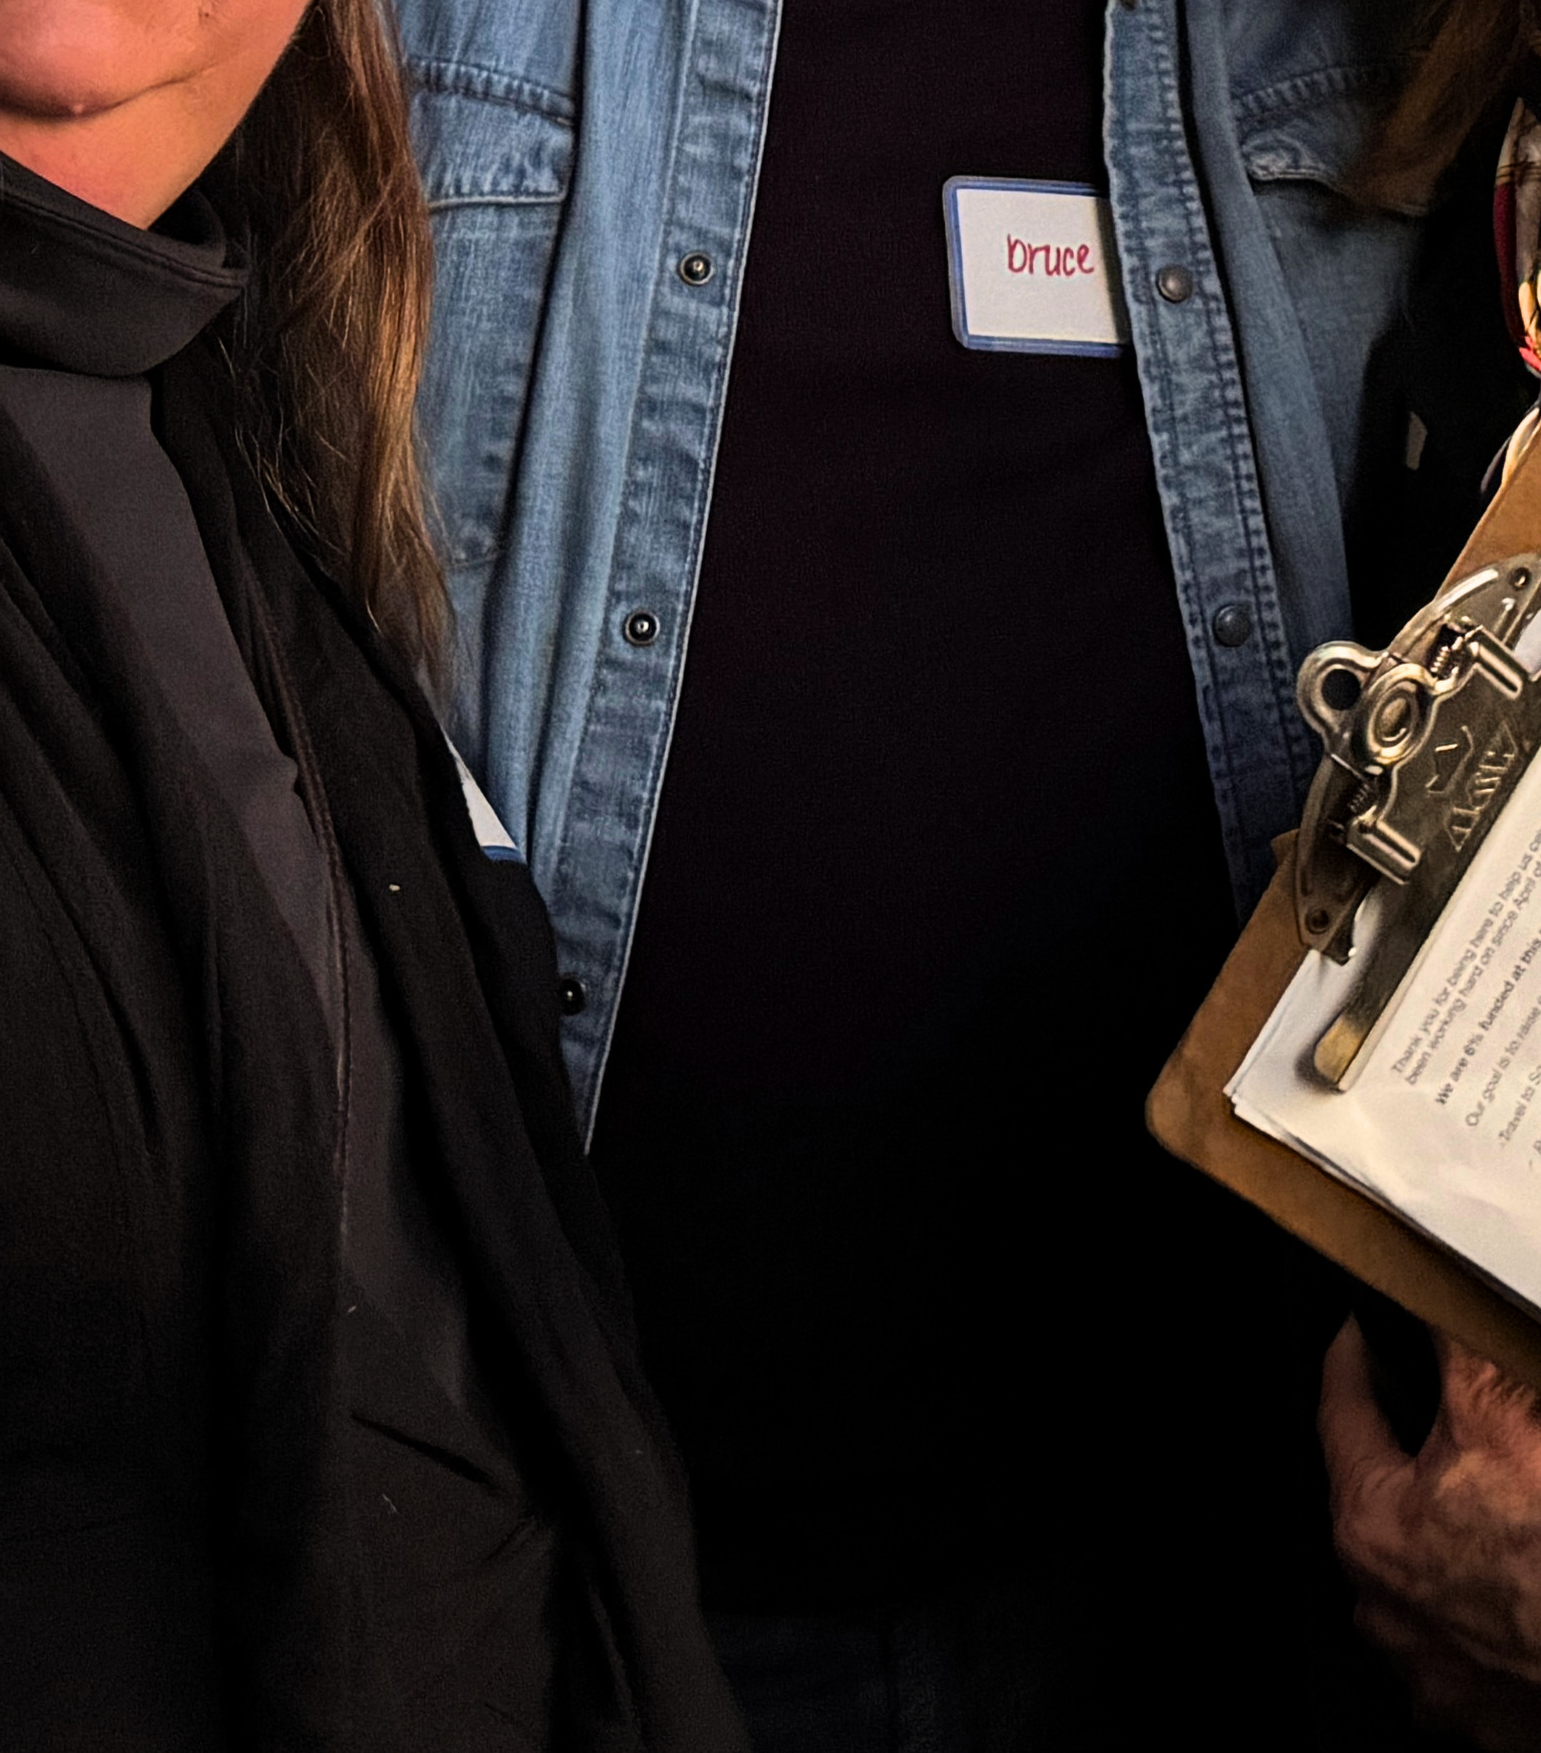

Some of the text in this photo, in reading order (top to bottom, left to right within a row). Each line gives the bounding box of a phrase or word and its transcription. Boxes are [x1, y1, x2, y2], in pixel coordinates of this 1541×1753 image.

[1007, 233, 1095, 277] bruce
[1389, 1035, 1423, 1074] Thank
[1418, 1007, 1440, 1035] you
[1431, 985, 1451, 1007] for
[1445, 947, 1477, 987] being
[1468, 917, 1494, 948] here
[1487, 900, 1504, 917] to
[1497, 870, 1522, 901] help
[1519, 852, 1534, 871] us
[1403, 1050, 1431, 1086] been
[1427, 997, 1468, 1050] working
[1457, 964, 1484, 997] hard
[1479, 945, 1496, 966] on
[1490, 909, 1518, 947] since
[1511, 876, 1537, 911] April
[1434, 1082, 1454, 1106] We
[1449, 1056, 1468, 1082] are
[1462, 1033, 1484, 1057] 6%
[1477, 979, 1515, 1031] funded
[1511, 963, 1526, 982] at
[1516, 1006, 1541, 1040] raise
[1497, 1056, 1511, 1070] is
[1503, 1039, 1520, 1056] to
[1481, 1068, 1503, 1103] goal
[1464, 1100, 1486, 1127] Our
[1497, 1102, 1527, 1142] Travel
[1519, 1085, 1536, 1103] to
